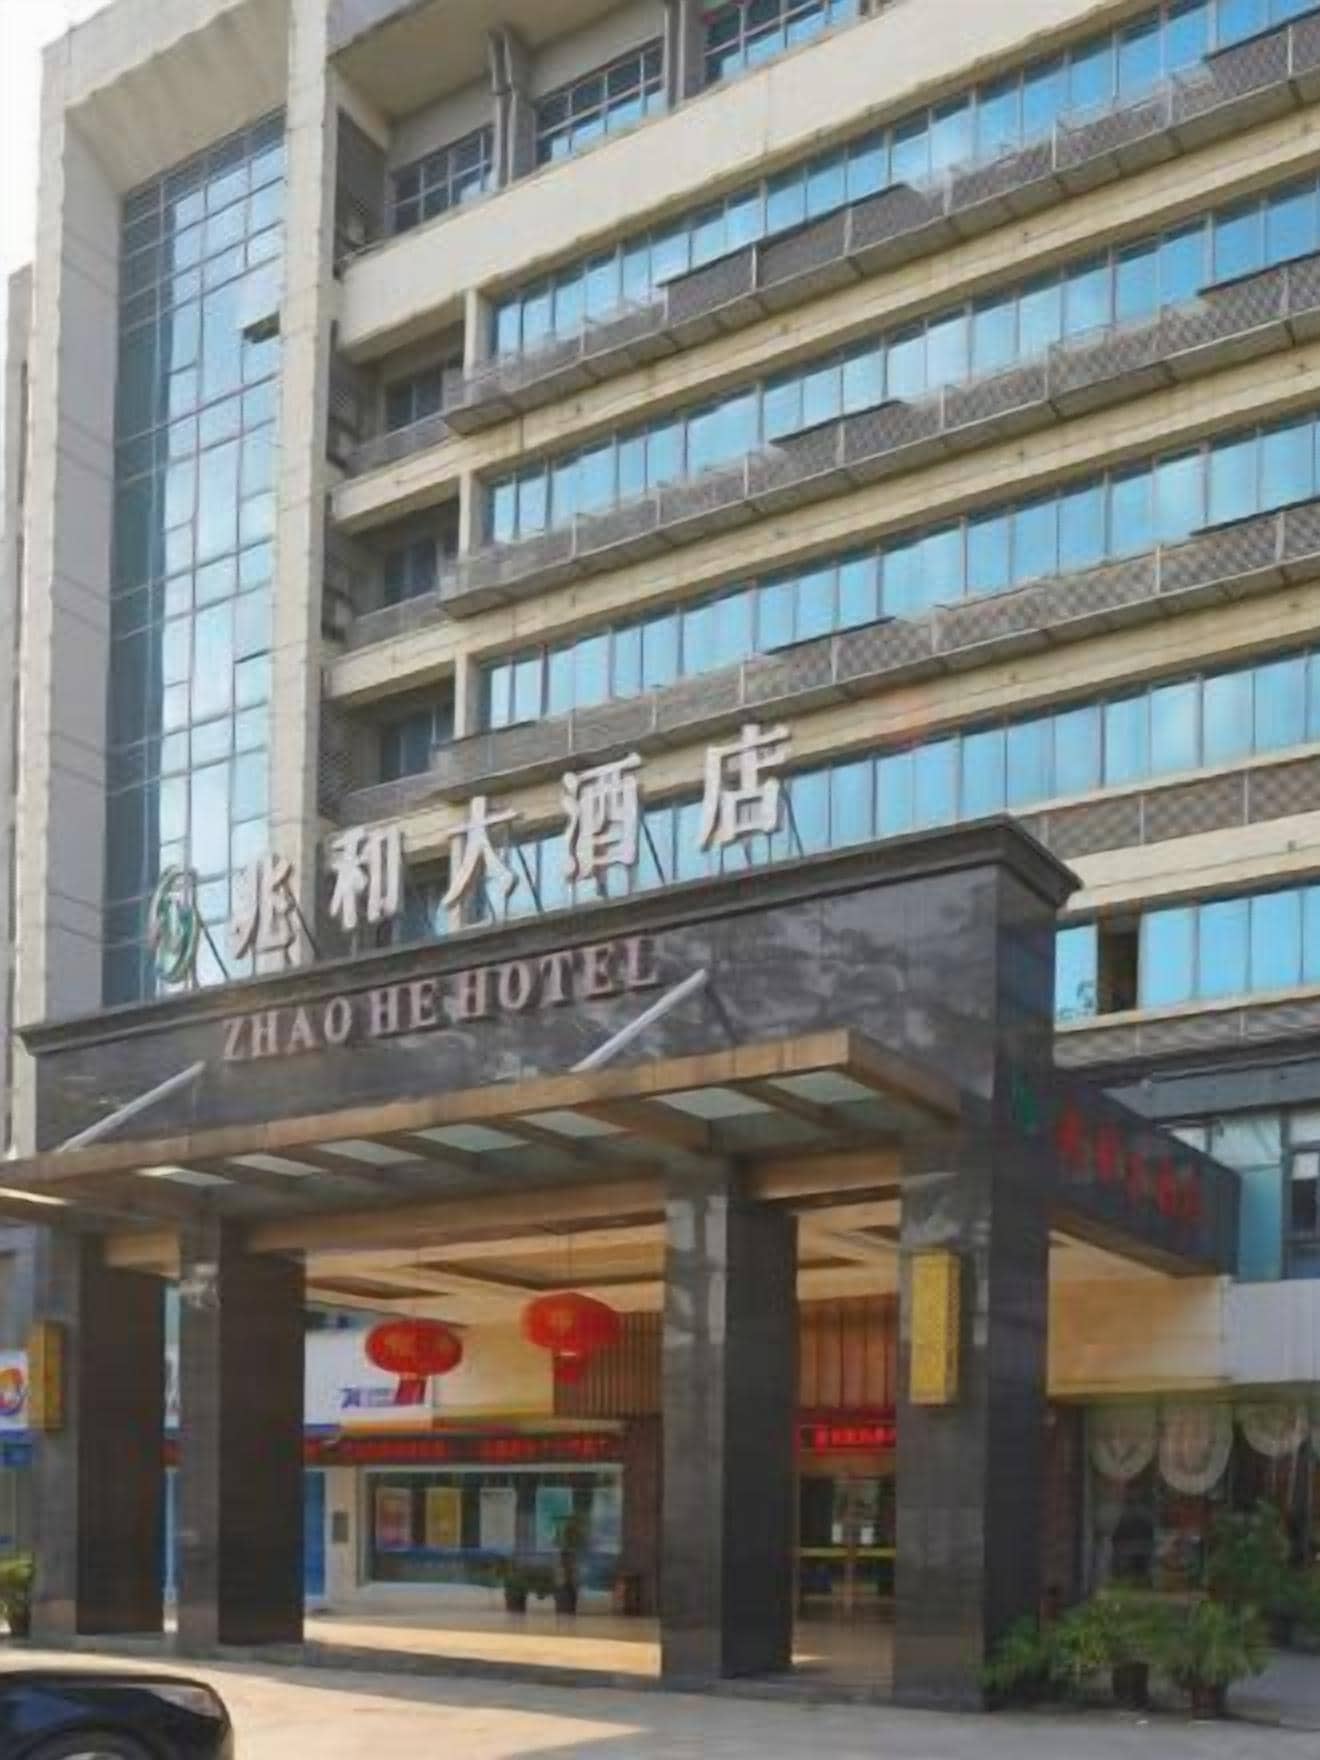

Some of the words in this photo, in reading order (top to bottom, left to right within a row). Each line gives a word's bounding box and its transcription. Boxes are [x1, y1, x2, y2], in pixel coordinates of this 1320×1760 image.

[234, 723, 791, 964] 兆和大酒店
[222, 996, 352, 1061] ZHAO
[458, 935, 659, 1019] HOTEL
